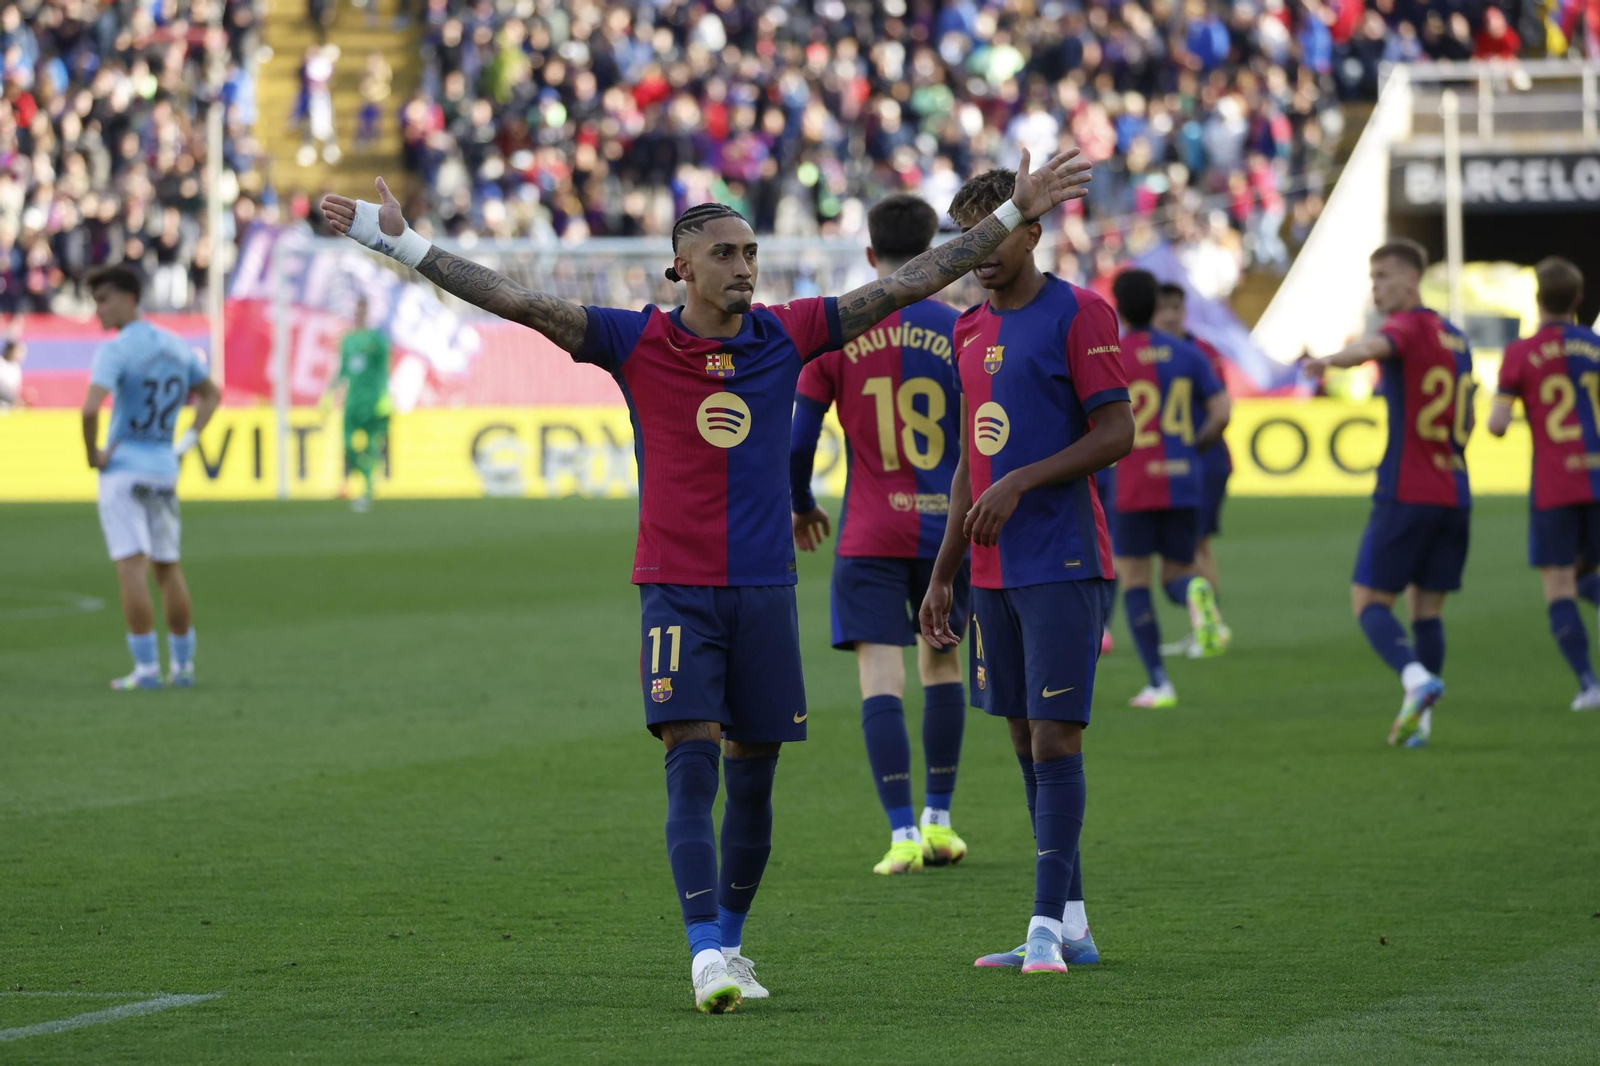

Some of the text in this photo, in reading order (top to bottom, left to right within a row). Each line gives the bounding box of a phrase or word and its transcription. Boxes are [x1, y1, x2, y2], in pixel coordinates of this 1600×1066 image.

[843, 326, 887, 364] PAU
[130, 375, 184, 432] 32
[861, 376, 947, 472] 18
[1127, 377, 1195, 448] 24
[1416, 365, 1473, 447] 20
[1539, 371, 1600, 445] 21
[648, 625, 682, 674] 11
